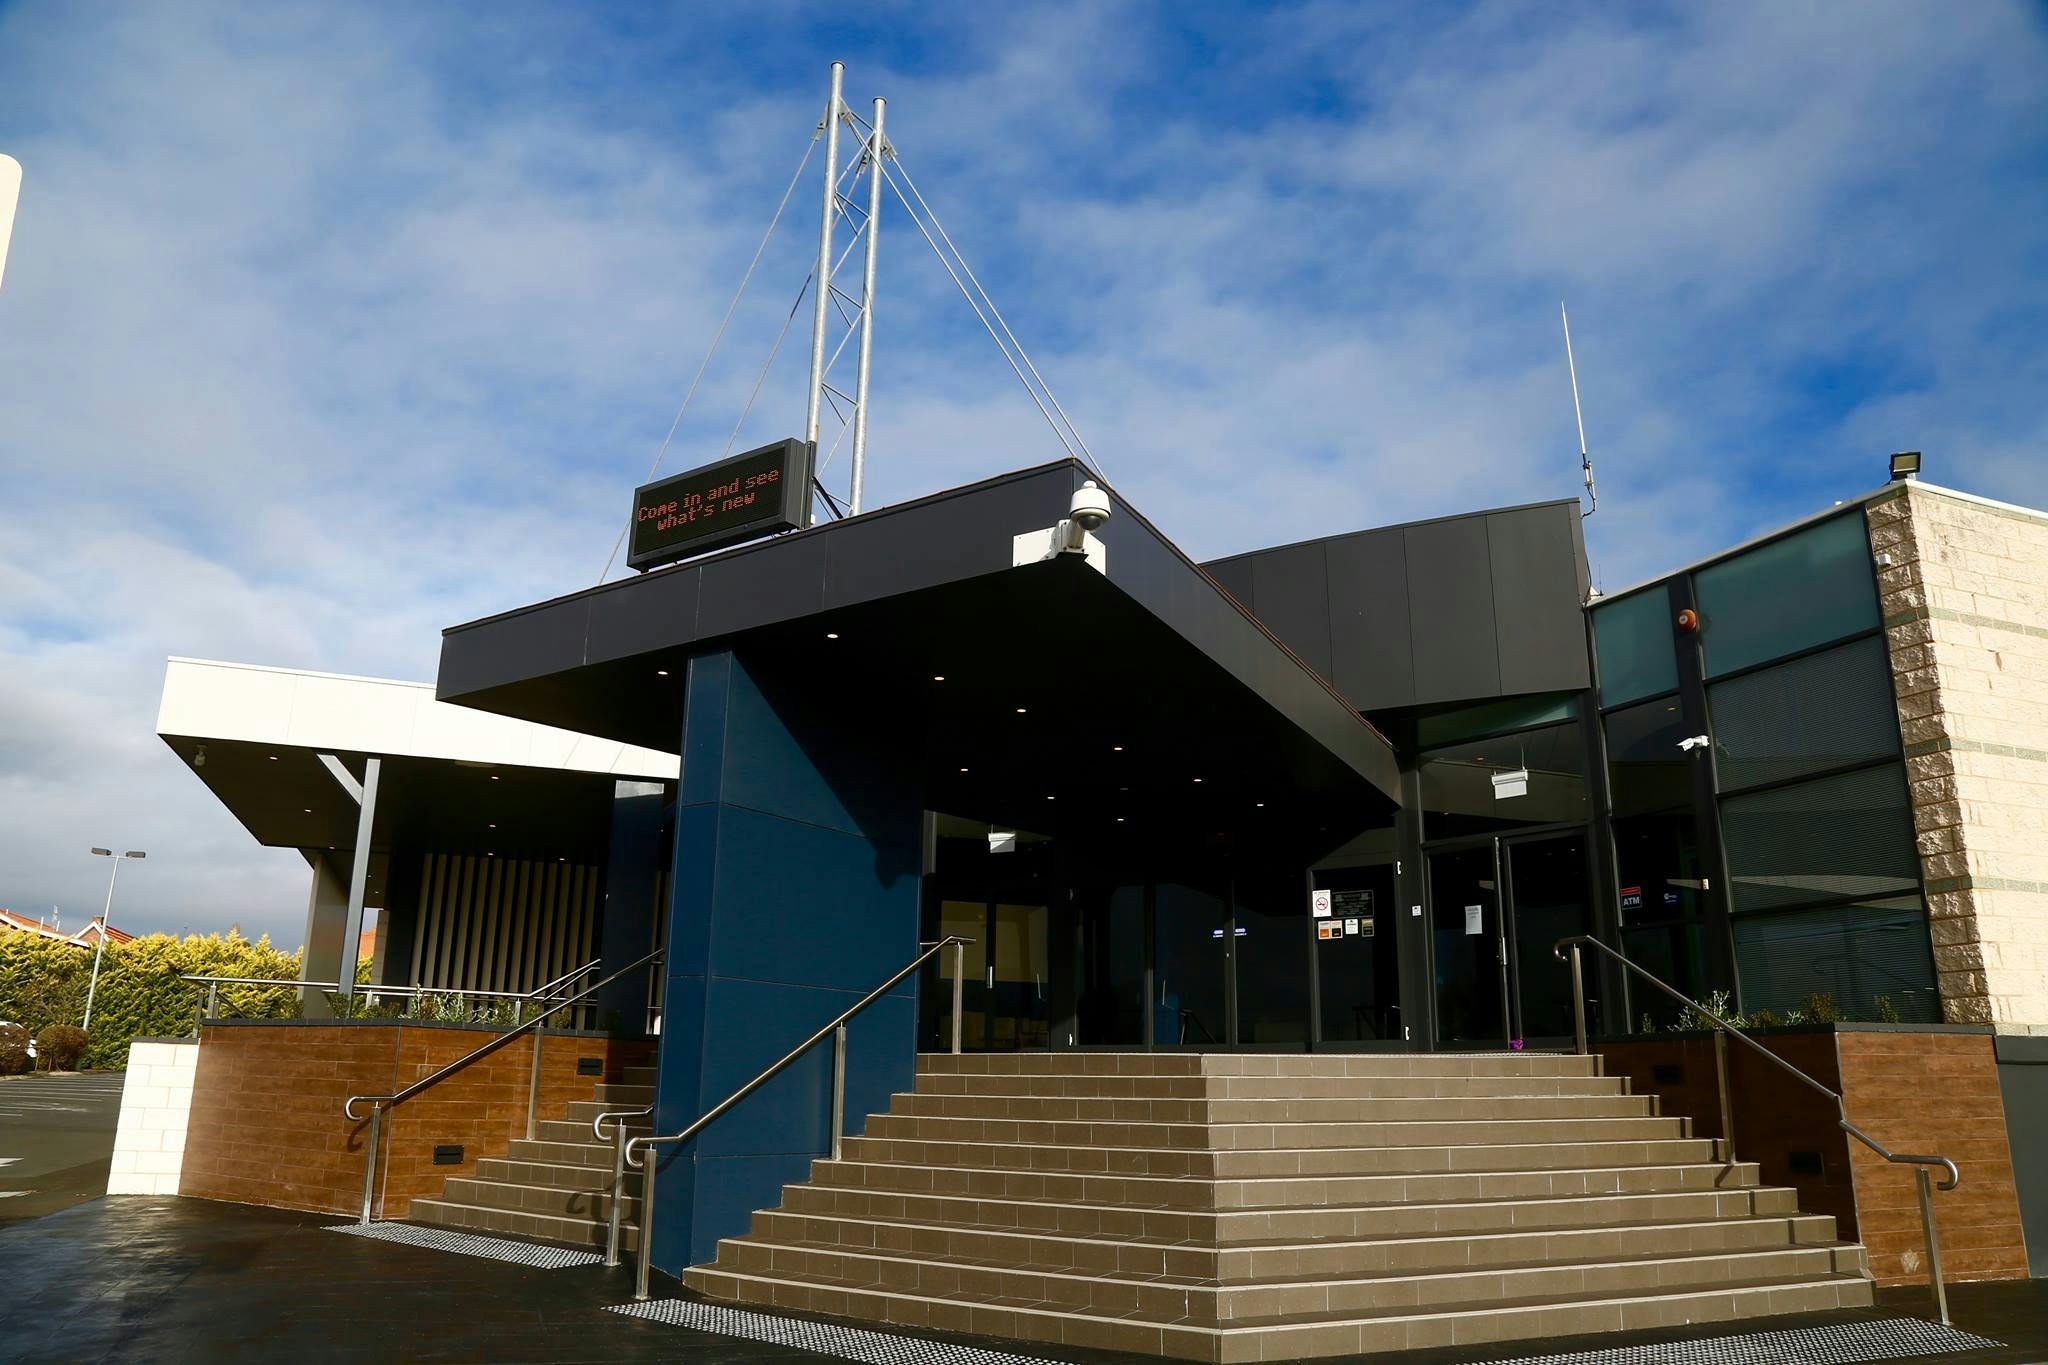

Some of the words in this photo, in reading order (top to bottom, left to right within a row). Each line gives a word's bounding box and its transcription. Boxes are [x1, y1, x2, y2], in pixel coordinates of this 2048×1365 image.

[638, 500, 678, 522] Come
[683, 493, 701, 508] in
[707, 477, 740, 500] and
[745, 468, 779, 489] see
[657, 504, 715, 531] what's
[721, 492, 756, 512] new
[1624, 896, 1640, 906] ATM
